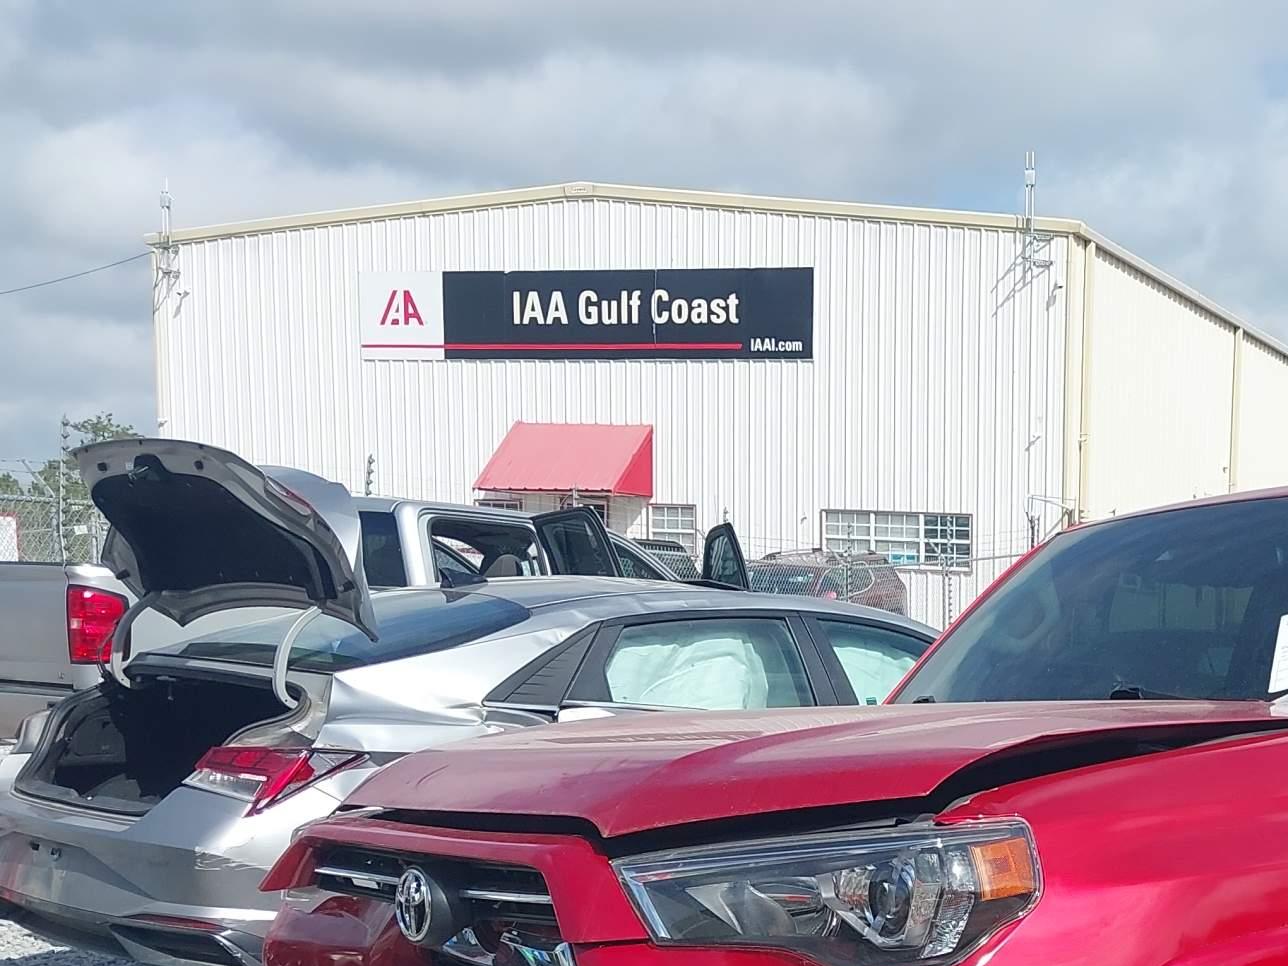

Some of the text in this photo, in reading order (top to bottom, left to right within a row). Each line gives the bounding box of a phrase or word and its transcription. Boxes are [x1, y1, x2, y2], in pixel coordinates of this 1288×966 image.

[512, 289, 740, 325] IAA Gulf Coast
[750, 338, 803, 352] IAAI.com
